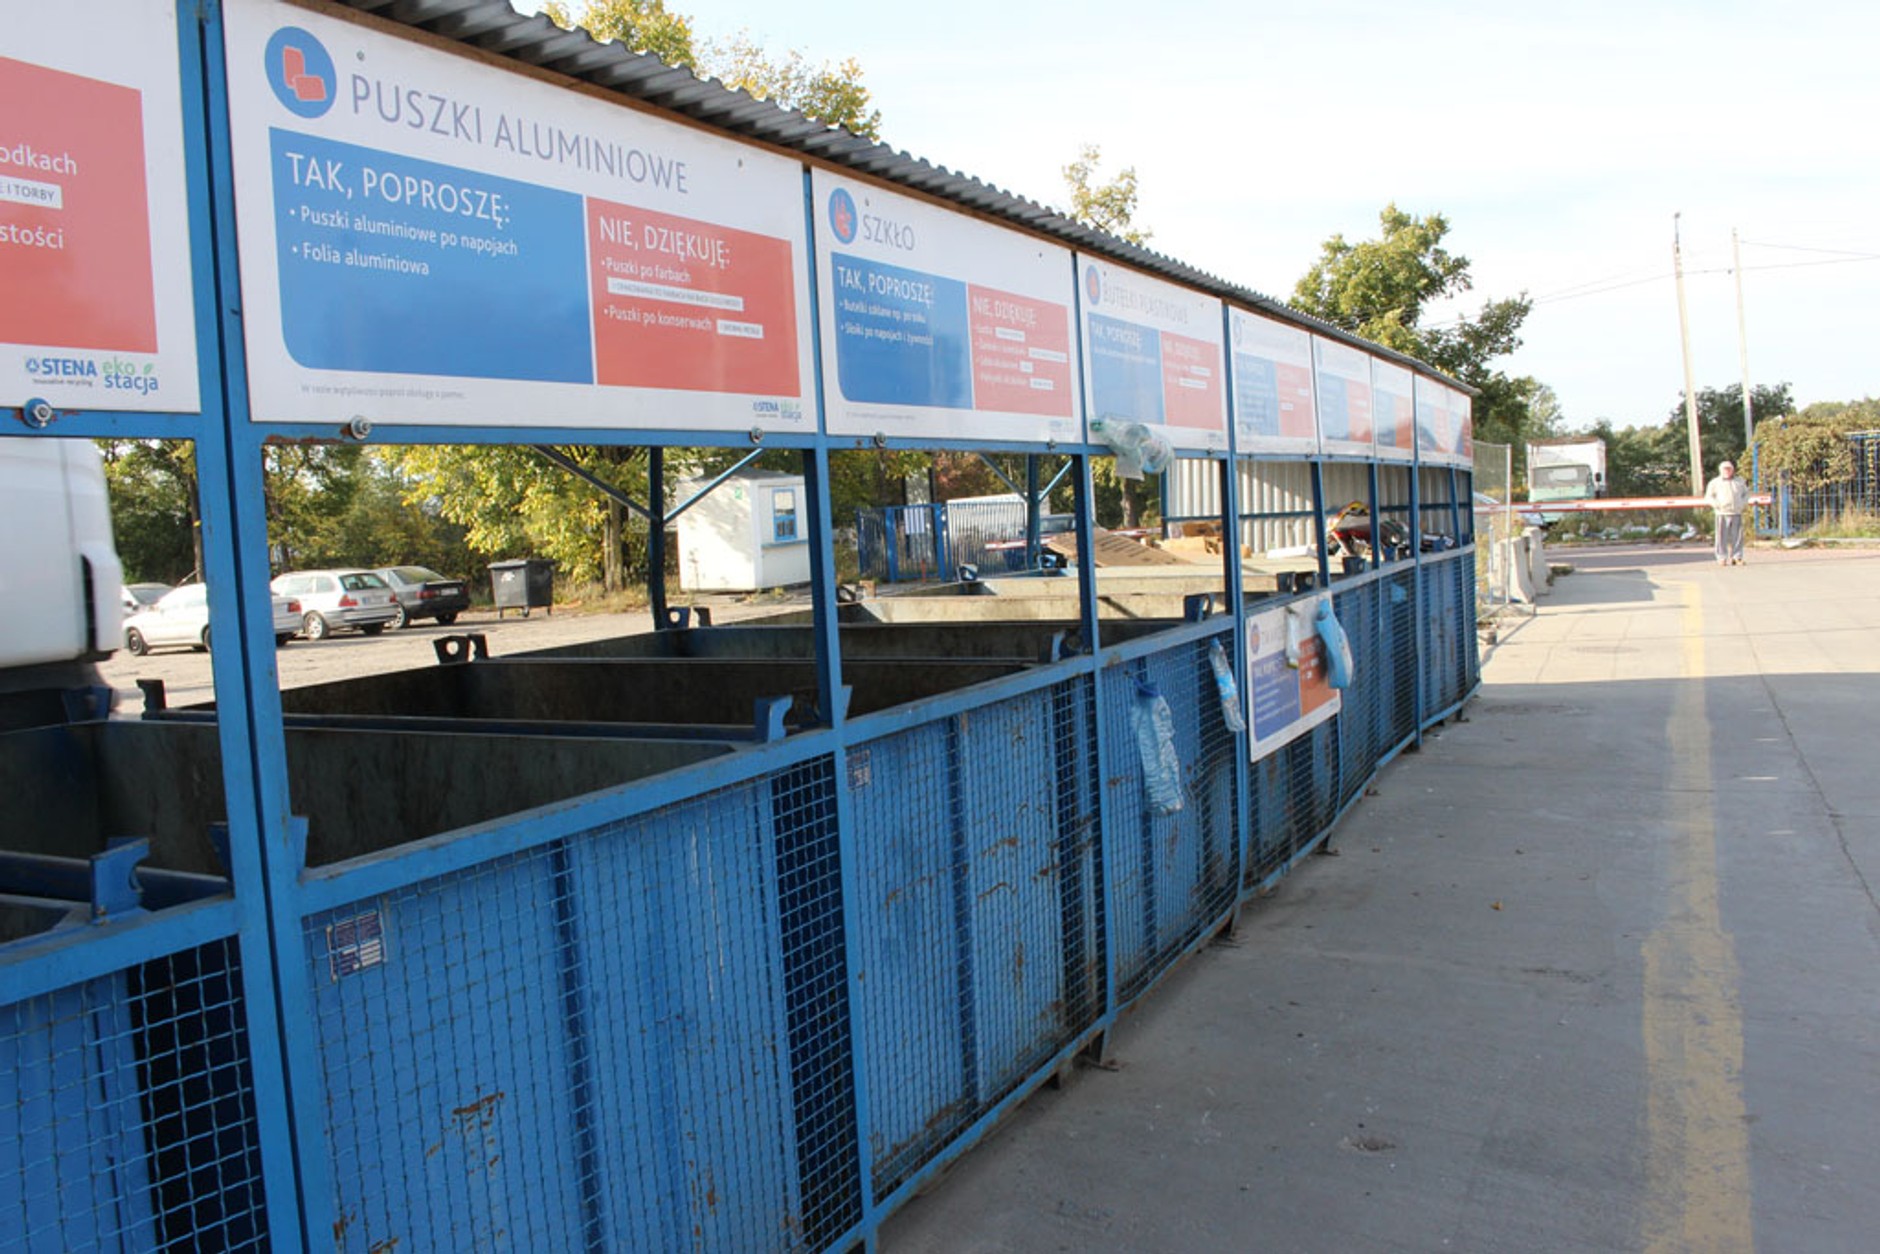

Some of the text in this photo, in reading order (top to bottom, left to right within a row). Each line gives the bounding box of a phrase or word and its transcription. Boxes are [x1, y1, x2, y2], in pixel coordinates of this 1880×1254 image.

[352, 73, 688, 194] PUSZKI ALUMINIOWE
[14, 184, 55, 202] TORBY
[286, 152, 510, 229] TAK, POPROSZĘ:
[301, 205, 518, 258] Puszki aluminiowe po napojach
[600, 216, 731, 269] NIE, DZIĘKUJĘ:
[862, 214, 915, 251] SZKŁO
[303, 242, 430, 275] Folia aluminiowa
[606, 256, 692, 283] Puszki po farbach
[609, 306, 641, 323] Puszki
[643, 312, 656, 328] po
[42, 355, 136, 377] STENA eko
[104, 372, 159, 395] stacja
